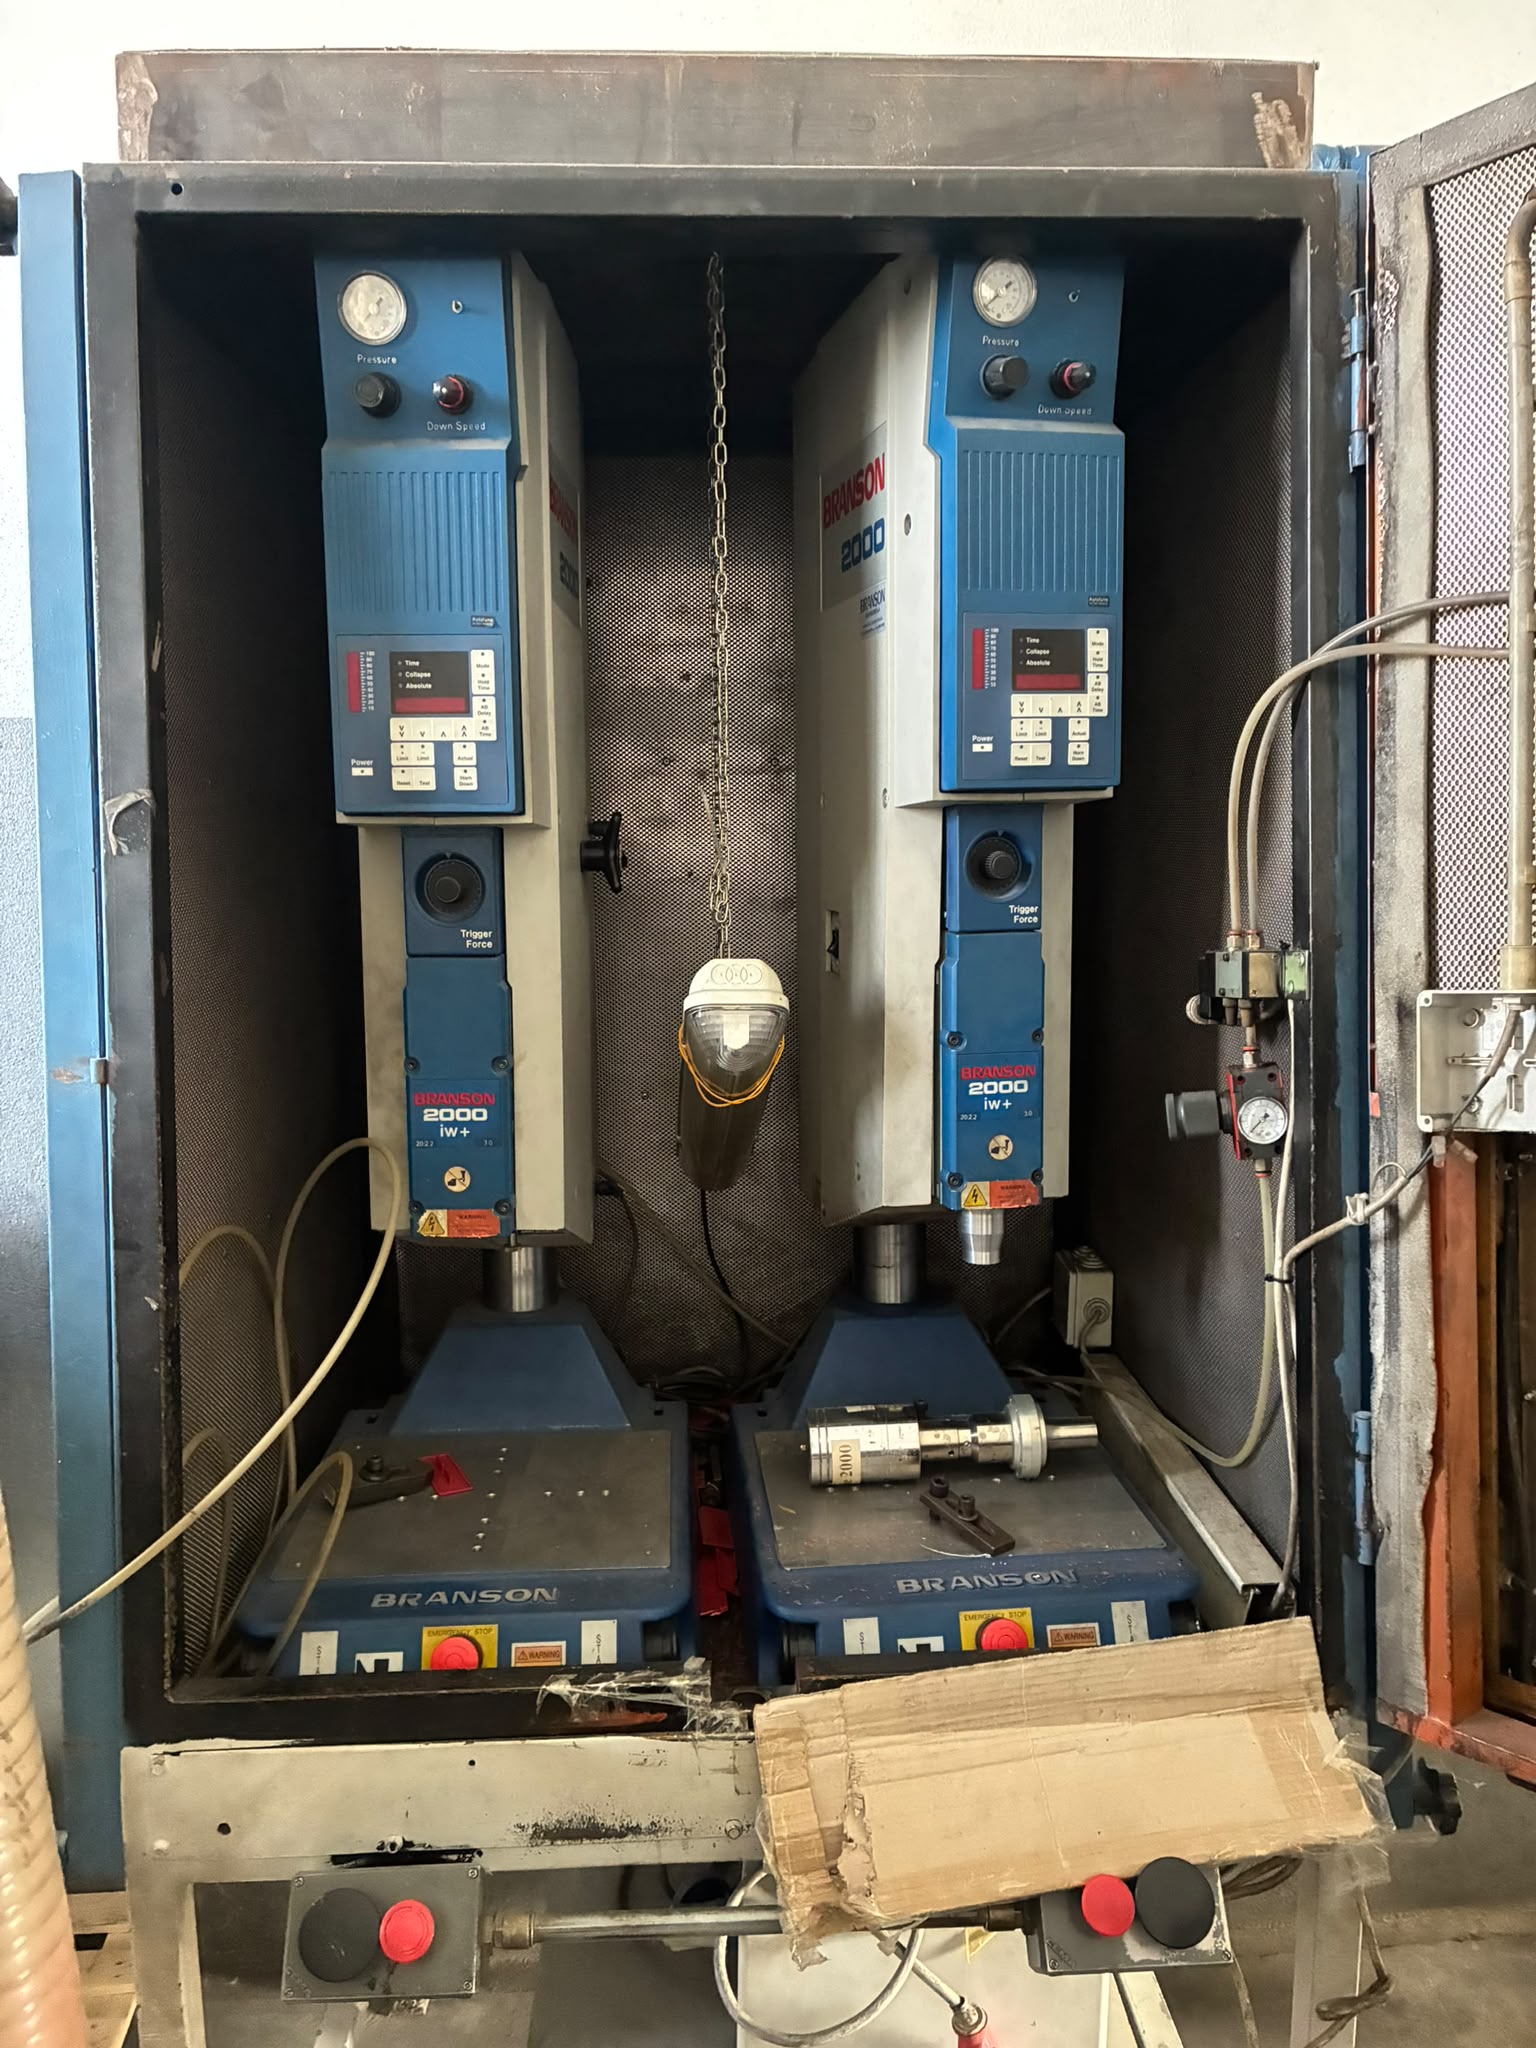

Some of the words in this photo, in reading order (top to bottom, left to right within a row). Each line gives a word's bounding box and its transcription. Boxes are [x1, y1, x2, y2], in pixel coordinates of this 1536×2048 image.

[982, 335, 1020, 347] Pressure
[357, 354, 397, 365] Pressure
[1037, 404, 1062, 415] Down
[1065, 407, 1092, 416] Speed
[426, 421, 453, 431] Down
[456, 421, 486, 432] Speed
[823, 452, 885, 530] BRANSON
[841, 517, 885, 573] 2000
[1026, 636, 1040, 644] Time
[405, 671, 431, 679] Collapse
[405, 682, 432, 690] Absolute
[972, 735, 994, 743] Power
[351, 759, 373, 767] Power
[1008, 905, 1039, 915] Trigger
[1013, 915, 1039, 924] Force
[460, 929, 493, 939] Trigger
[466, 939, 493, 948] Force
[960, 1065, 1036, 1080] BRANSON
[968, 1080, 1029, 1095] 2000
[413, 1092, 496, 1106] BRANSON
[423, 1108, 488, 1122] 2000
[896, 1568, 1080, 1594] BRANSON
[370, 1586, 559, 1608] BRANSON
[1009, 1610, 1028, 1619] STOP
[474, 1627, 493, 1636] STOP
[1064, 1631, 1095, 1640] WARNING
[528, 1649, 560, 1659] WARNING
